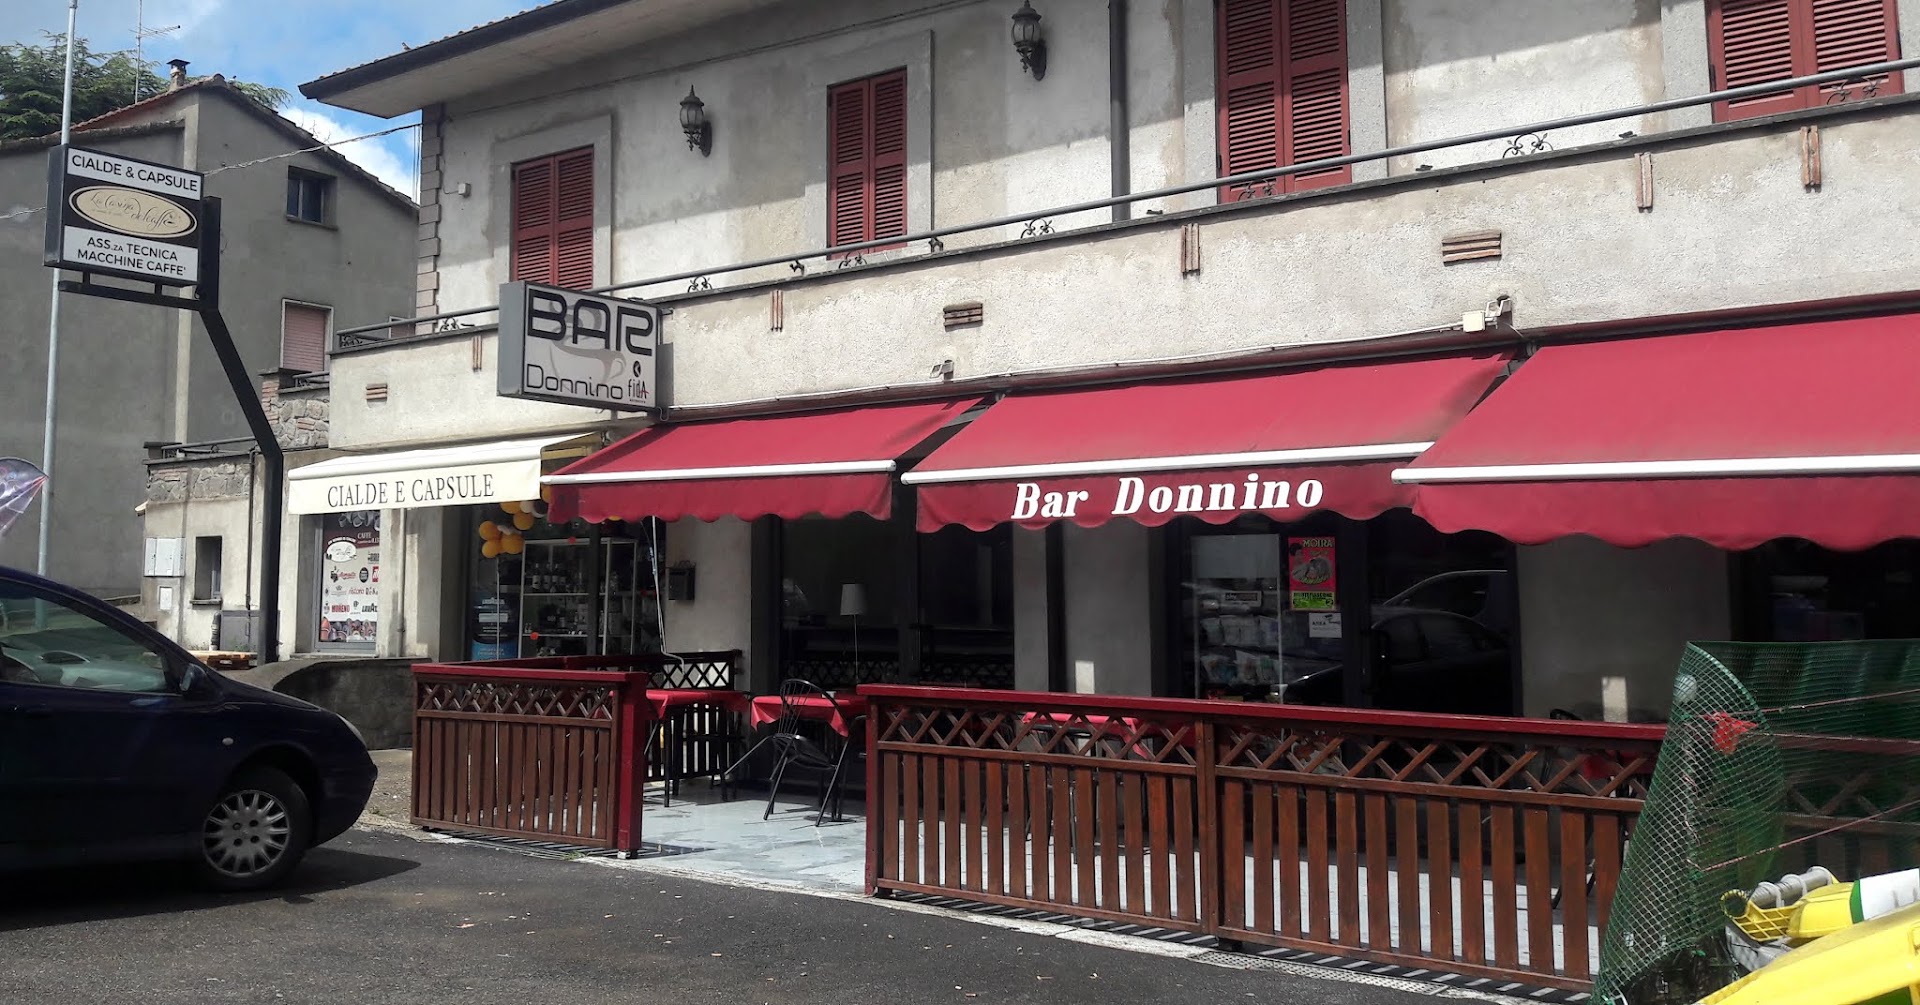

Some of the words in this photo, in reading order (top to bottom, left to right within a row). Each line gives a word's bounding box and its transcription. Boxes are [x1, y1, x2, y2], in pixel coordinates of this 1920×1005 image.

[71, 154, 122, 176] CIALDE
[125, 166, 135, 179] &
[137, 169, 198, 192] CAPSULE
[77, 248, 143, 270] MACCHINE
[126, 242, 178, 262] TECNICA
[527, 288, 654, 357] BAR
[526, 363, 624, 400] Donnino
[327, 480, 389, 508] CIALDE
[394, 480, 406, 503] E
[411, 473, 495, 502] CAPSULE
[1010, 481, 1090, 520] Bar
[1111, 472, 1324, 516] Donnino
[1302, 539, 1333, 548] MOIRA
